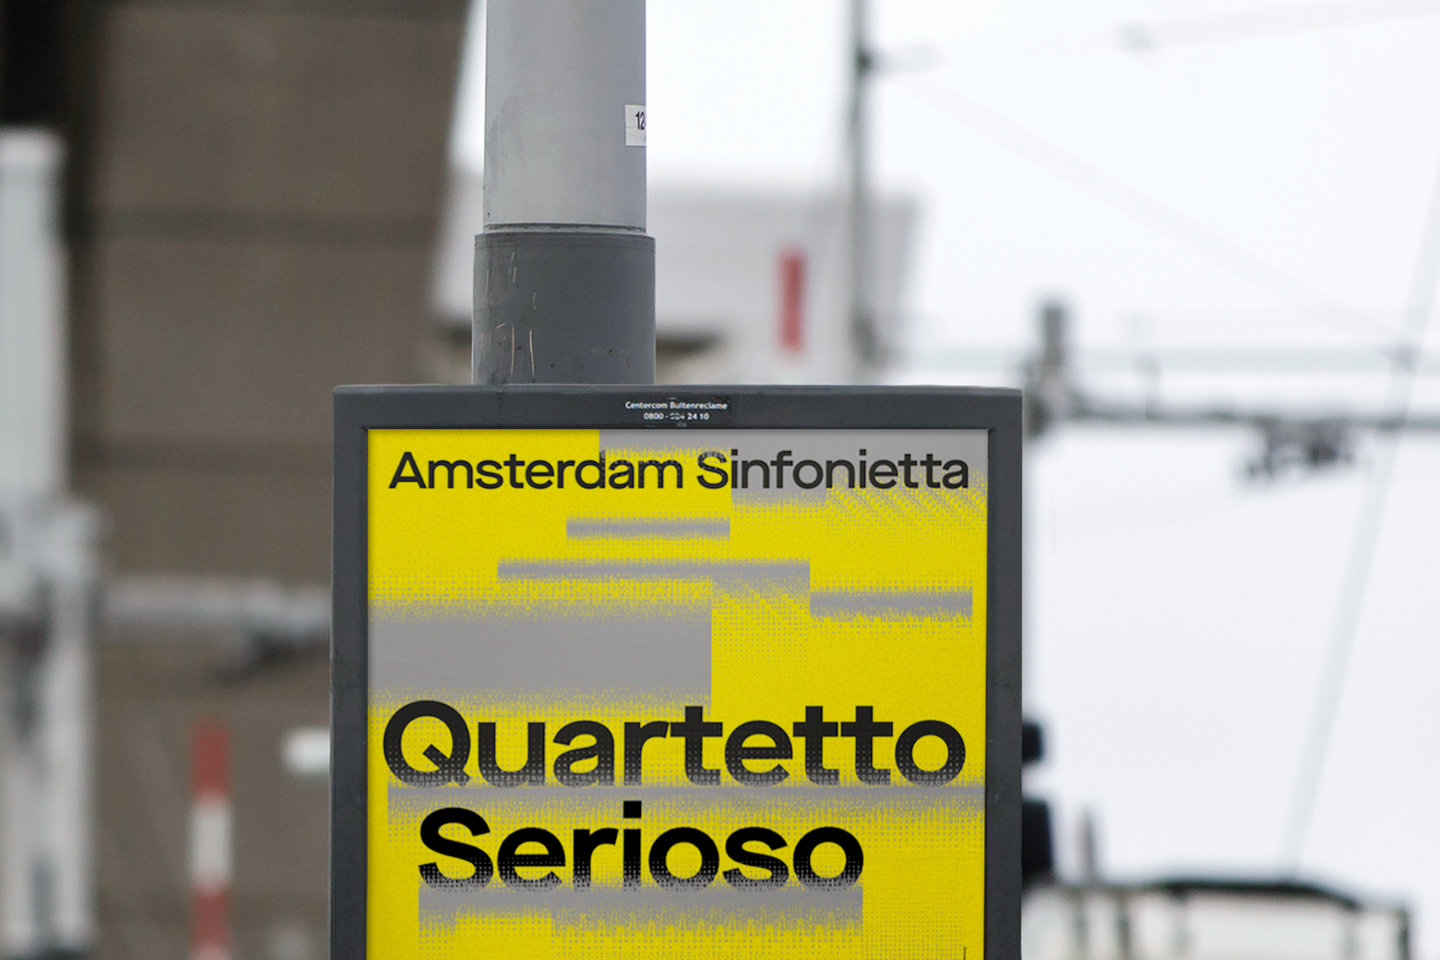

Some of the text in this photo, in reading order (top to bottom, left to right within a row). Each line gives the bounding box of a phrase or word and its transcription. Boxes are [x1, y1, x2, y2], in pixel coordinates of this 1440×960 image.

[635, 110, 646, 130] 12
[625, 401, 668, 410] Centercom
[643, 412, 664, 420] 0800
[388, 448, 969, 489] Amsterdam Sinfonietta
[383, 700, 966, 788] Quartetto
[418, 801, 864, 892] Serioso
